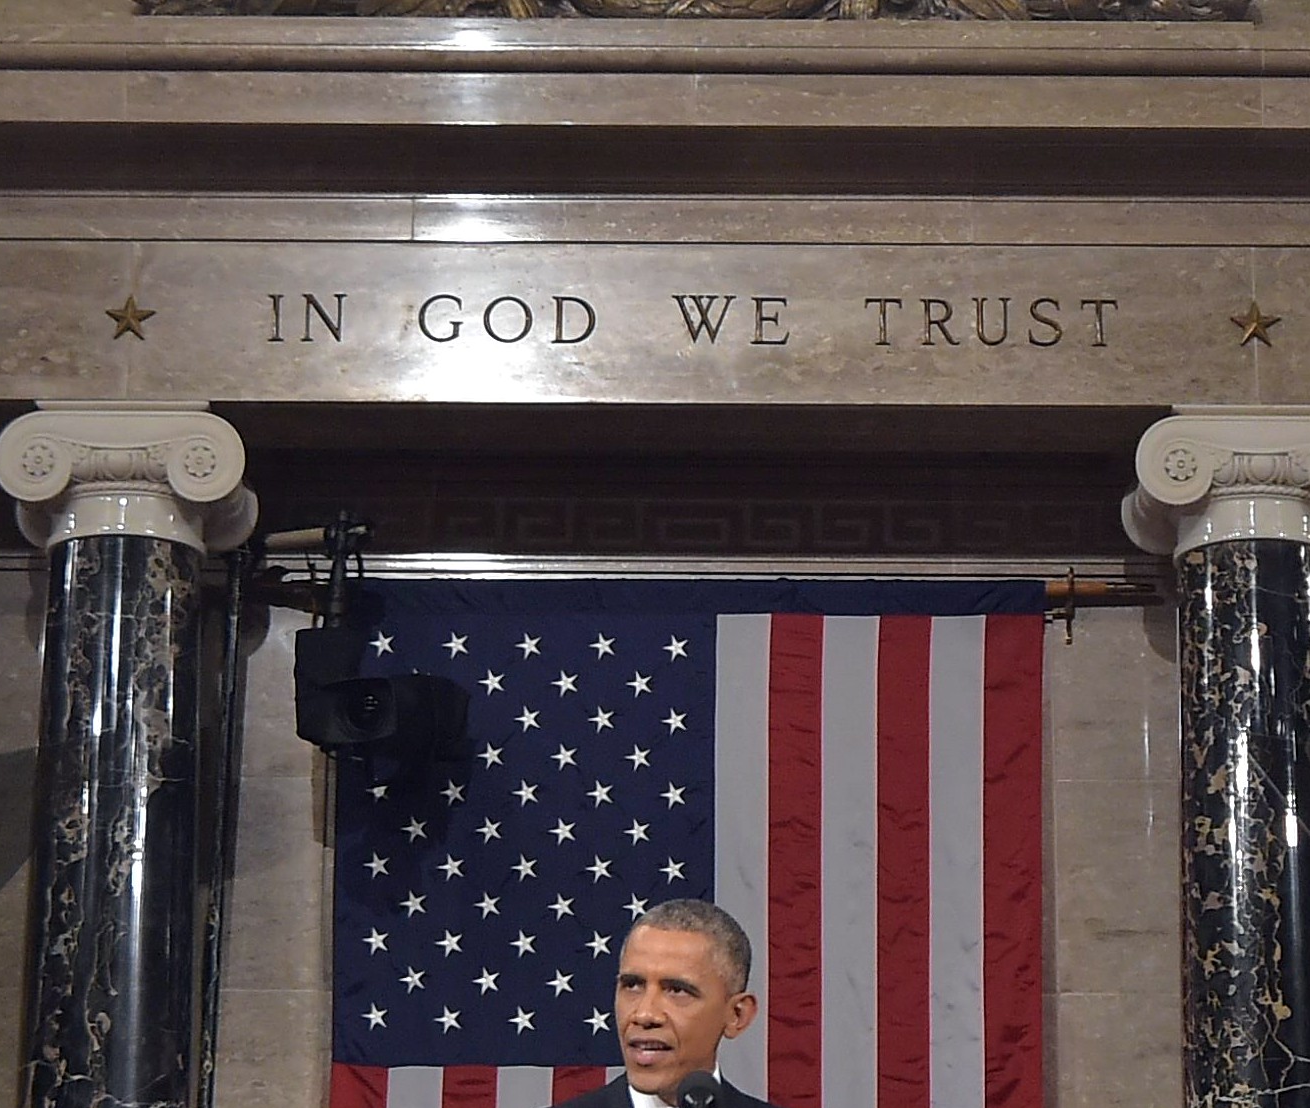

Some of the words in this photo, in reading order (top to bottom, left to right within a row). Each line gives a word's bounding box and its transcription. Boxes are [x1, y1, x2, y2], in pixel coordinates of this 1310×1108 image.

[267, 294, 348, 342] IN
[418, 294, 596, 344] GOD
[671, 294, 790, 345] WE
[864, 297, 1119, 347] TRUST
